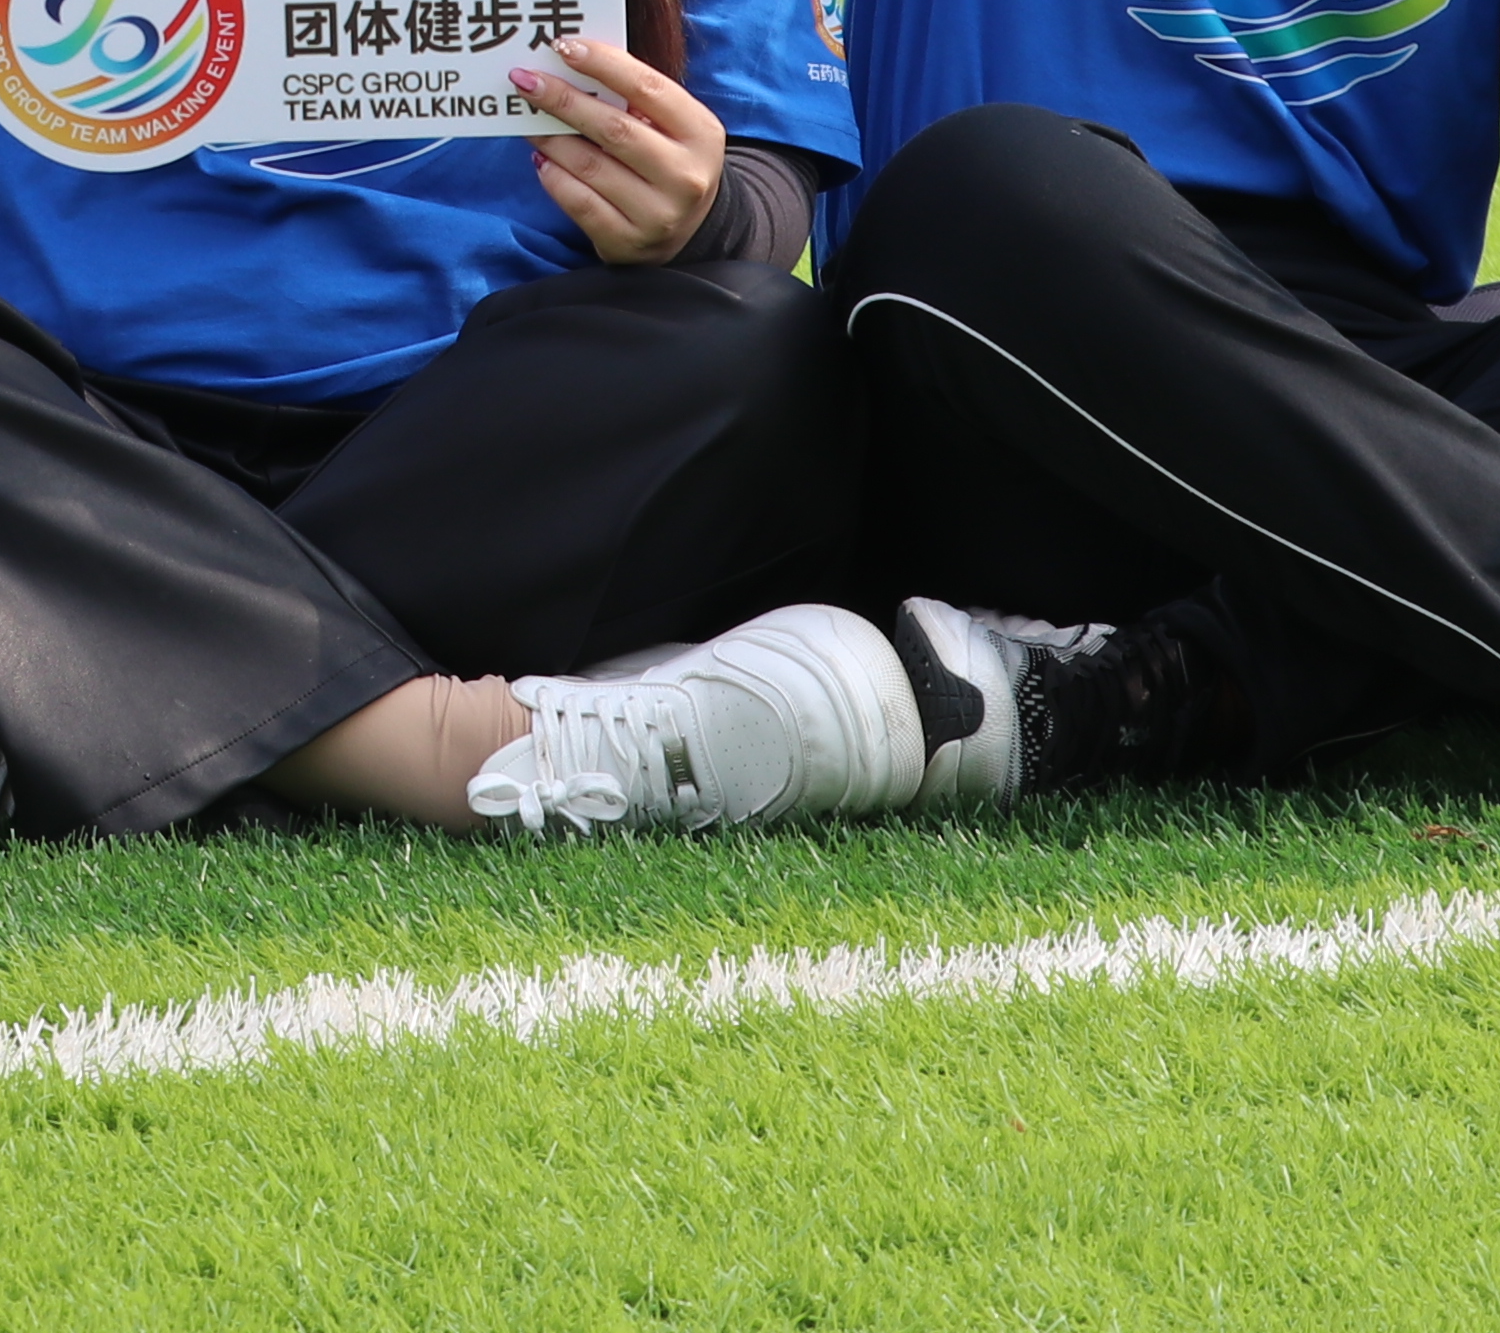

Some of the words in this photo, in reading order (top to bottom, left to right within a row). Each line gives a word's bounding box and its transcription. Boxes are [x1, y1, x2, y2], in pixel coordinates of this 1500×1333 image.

[4, 75, 65, 131] GROUP
[70, 122, 127, 144] TEAM
[131, 79, 215, 141] WALKING
[206, 10, 234, 79] EVENT
[283, 72, 354, 96] CSPC
[361, 70, 460, 94] GROUP
[284, 98, 361, 121] TEAM
[370, 96, 498, 118] WALKING
